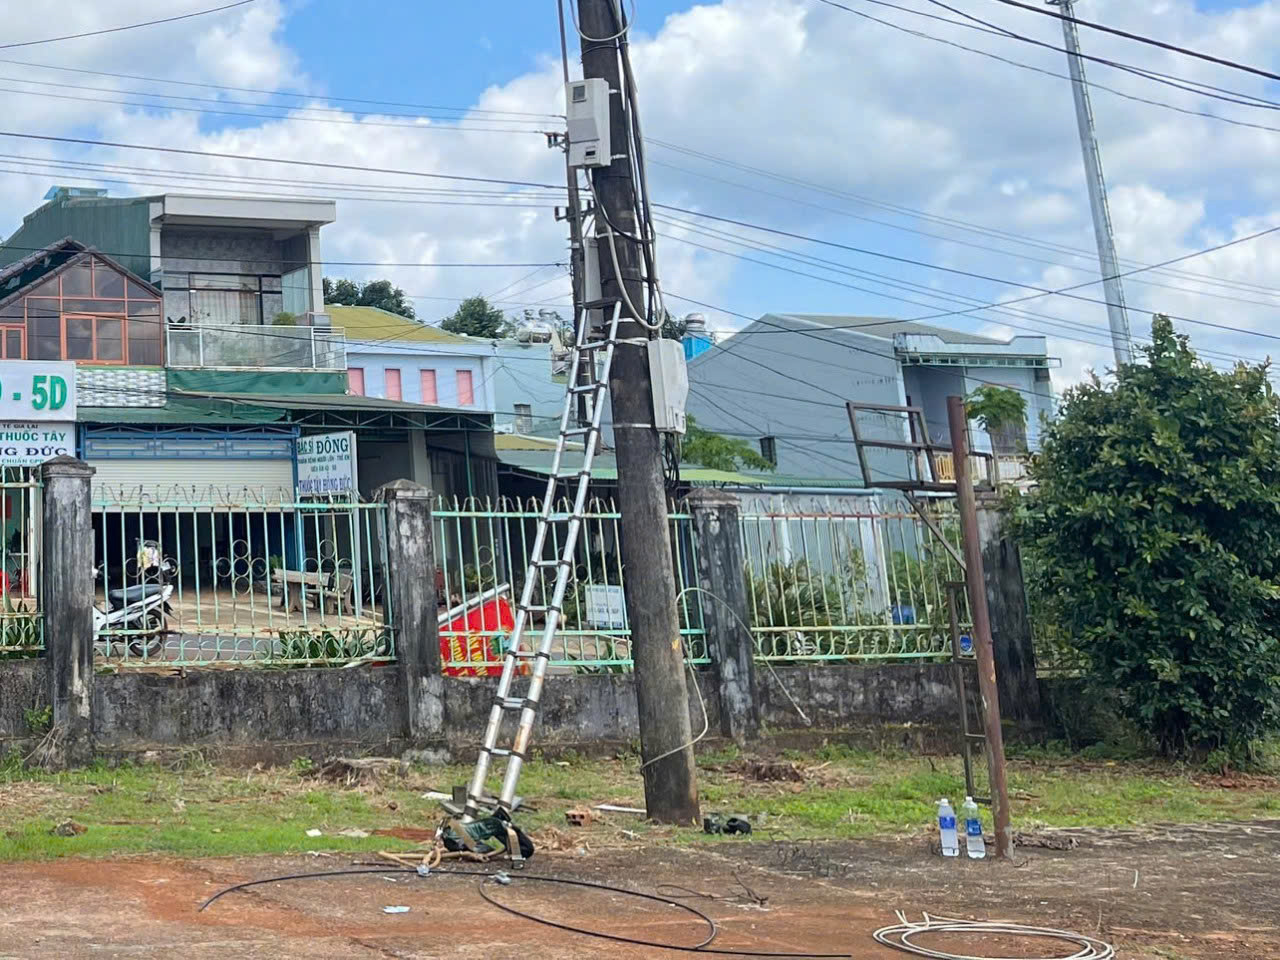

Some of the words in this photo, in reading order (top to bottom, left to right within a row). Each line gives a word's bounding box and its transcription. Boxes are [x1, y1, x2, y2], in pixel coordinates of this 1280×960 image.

[31, 375, 67, 410] 5D
[42, 429, 66, 442] TÂY
[26, 445, 67, 456] ĐỨC
[316, 436, 348, 455] ĐÔNG
